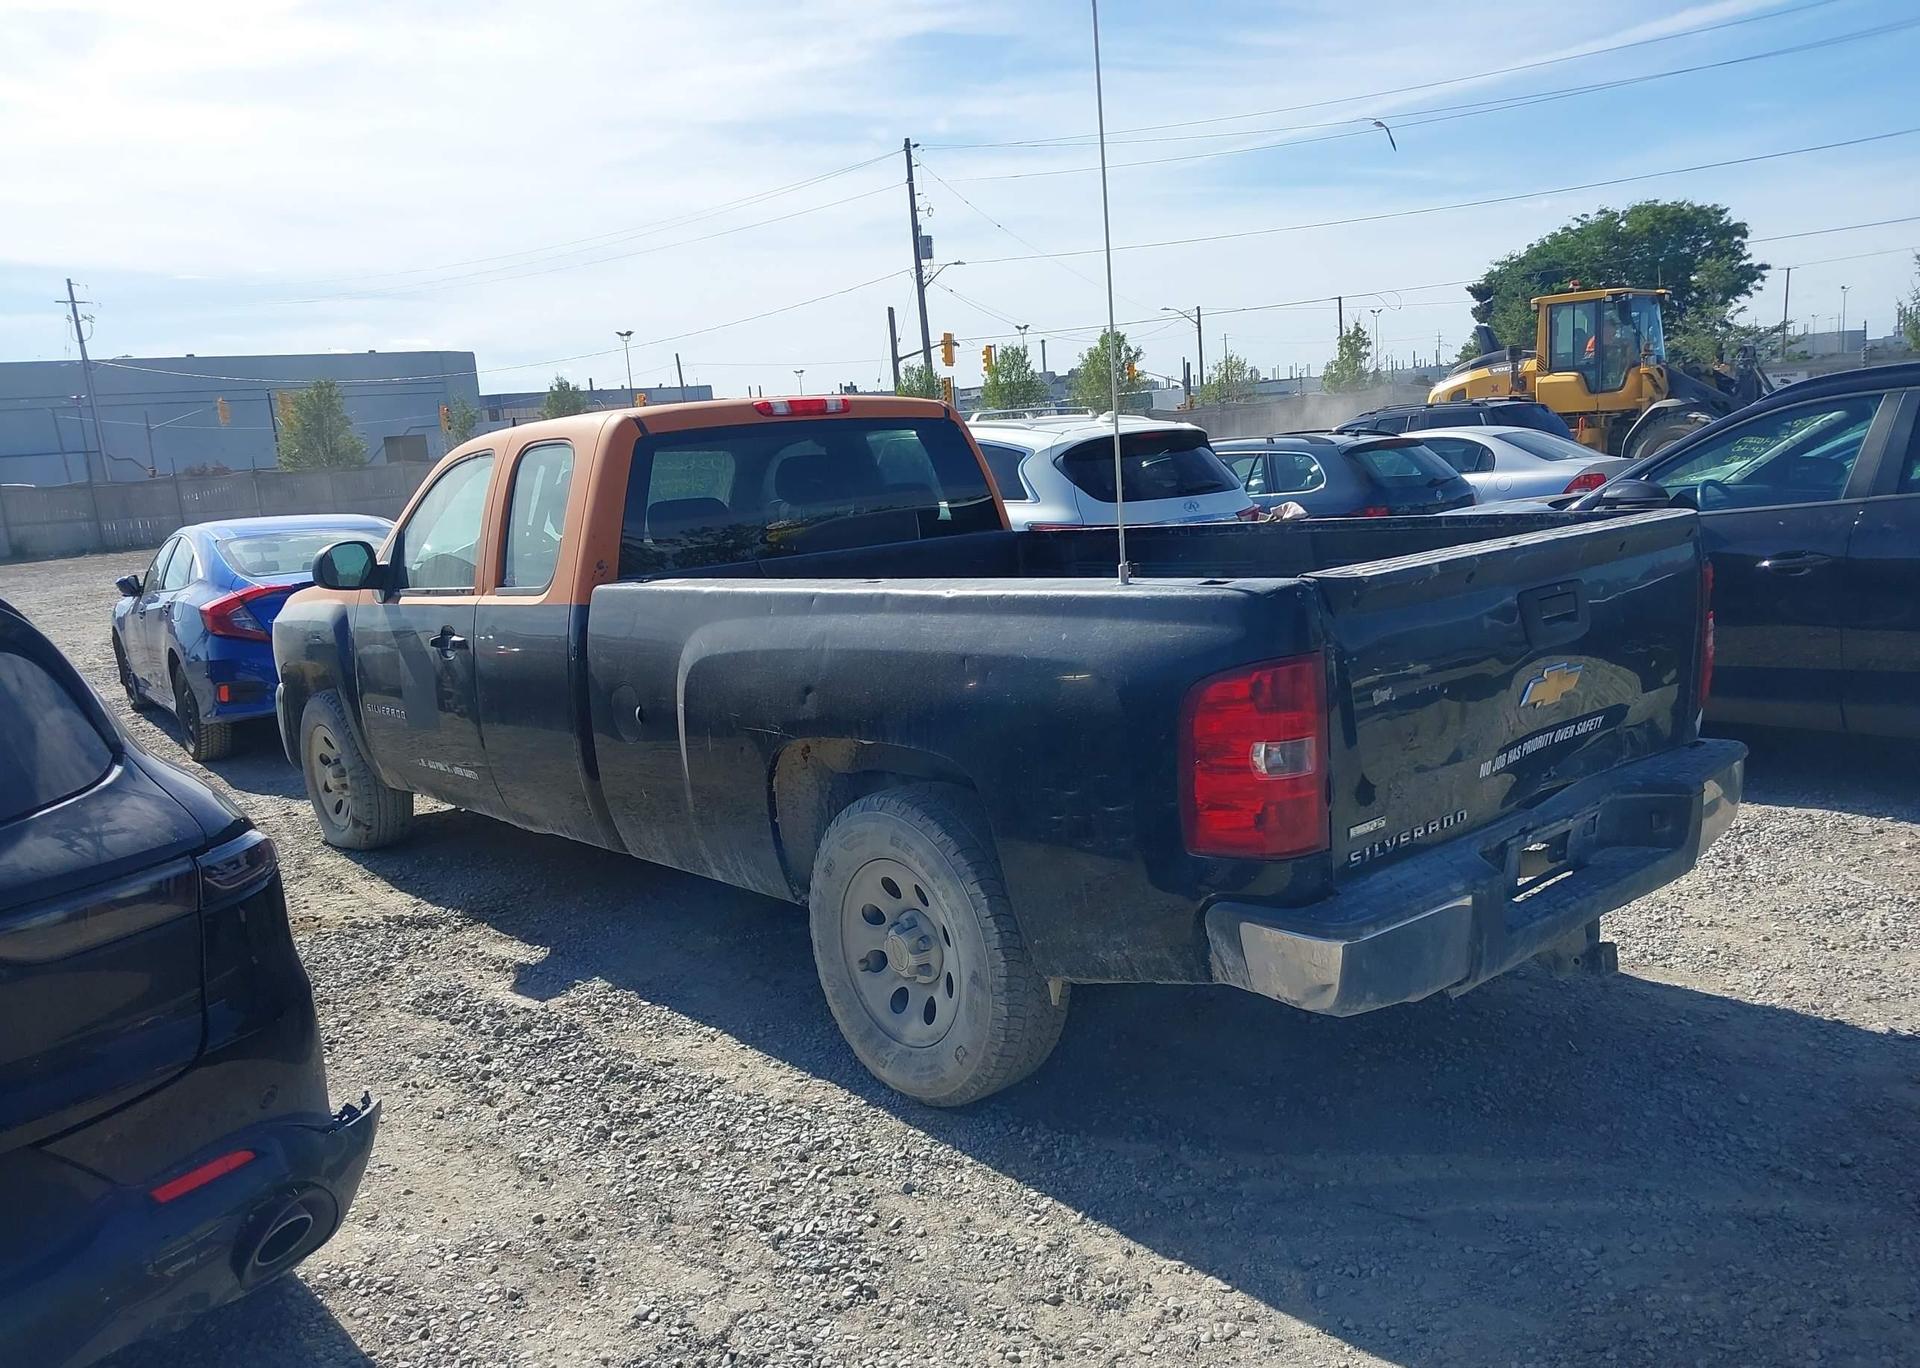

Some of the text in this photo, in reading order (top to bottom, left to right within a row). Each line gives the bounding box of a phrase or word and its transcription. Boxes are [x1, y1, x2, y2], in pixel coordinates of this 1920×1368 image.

[1491, 363, 1523, 373] VOLO
[366, 703, 406, 720] SILVERADO
[1480, 715, 1605, 779] NO JOB HAS PRIORITY OVER SAFETY
[1348, 809, 1468, 868] SILVERADO
